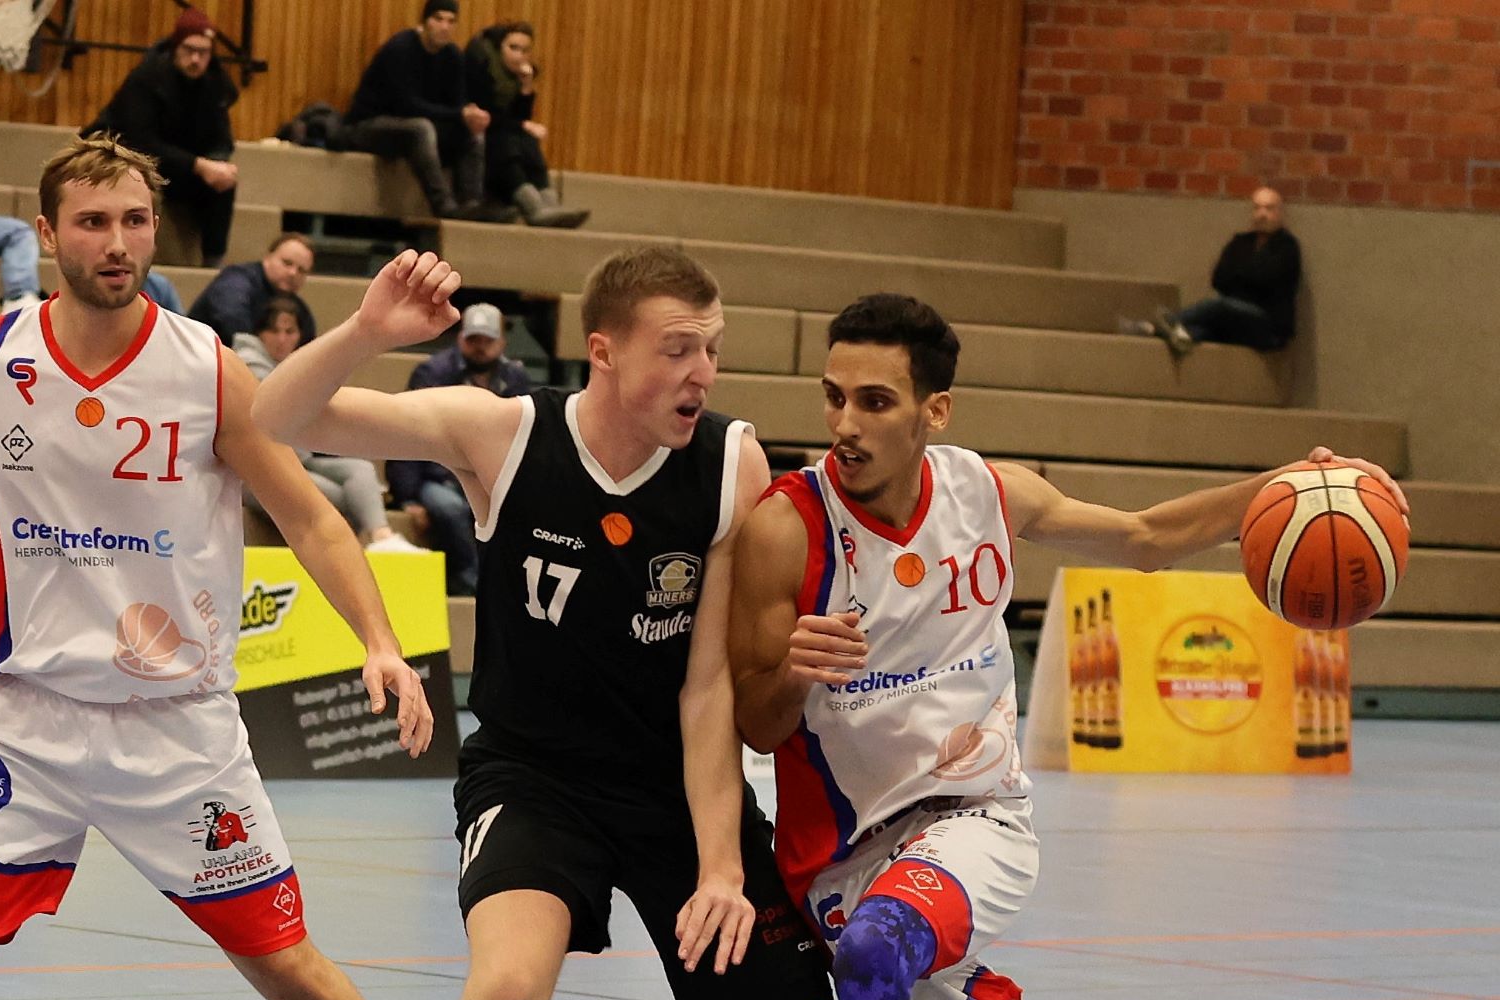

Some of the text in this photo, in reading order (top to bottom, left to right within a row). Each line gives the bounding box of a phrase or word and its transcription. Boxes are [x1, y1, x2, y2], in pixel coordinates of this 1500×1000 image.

[112, 416, 183, 481] 21
[12, 517, 150, 554] Creitreform
[15, 546, 67, 558] HERFOR
[532, 528, 575, 547] CRAFT
[522, 555, 582, 627] 17
[938, 543, 1007, 615] 10
[649, 590, 694, 603] MINERS
[629, 610, 693, 645] Staude
[886, 680, 938, 701] MINDEN
[201, 844, 262, 869] UHLAND
[461, 803, 504, 879] 17
[193, 852, 274, 884] APOTHEKE
